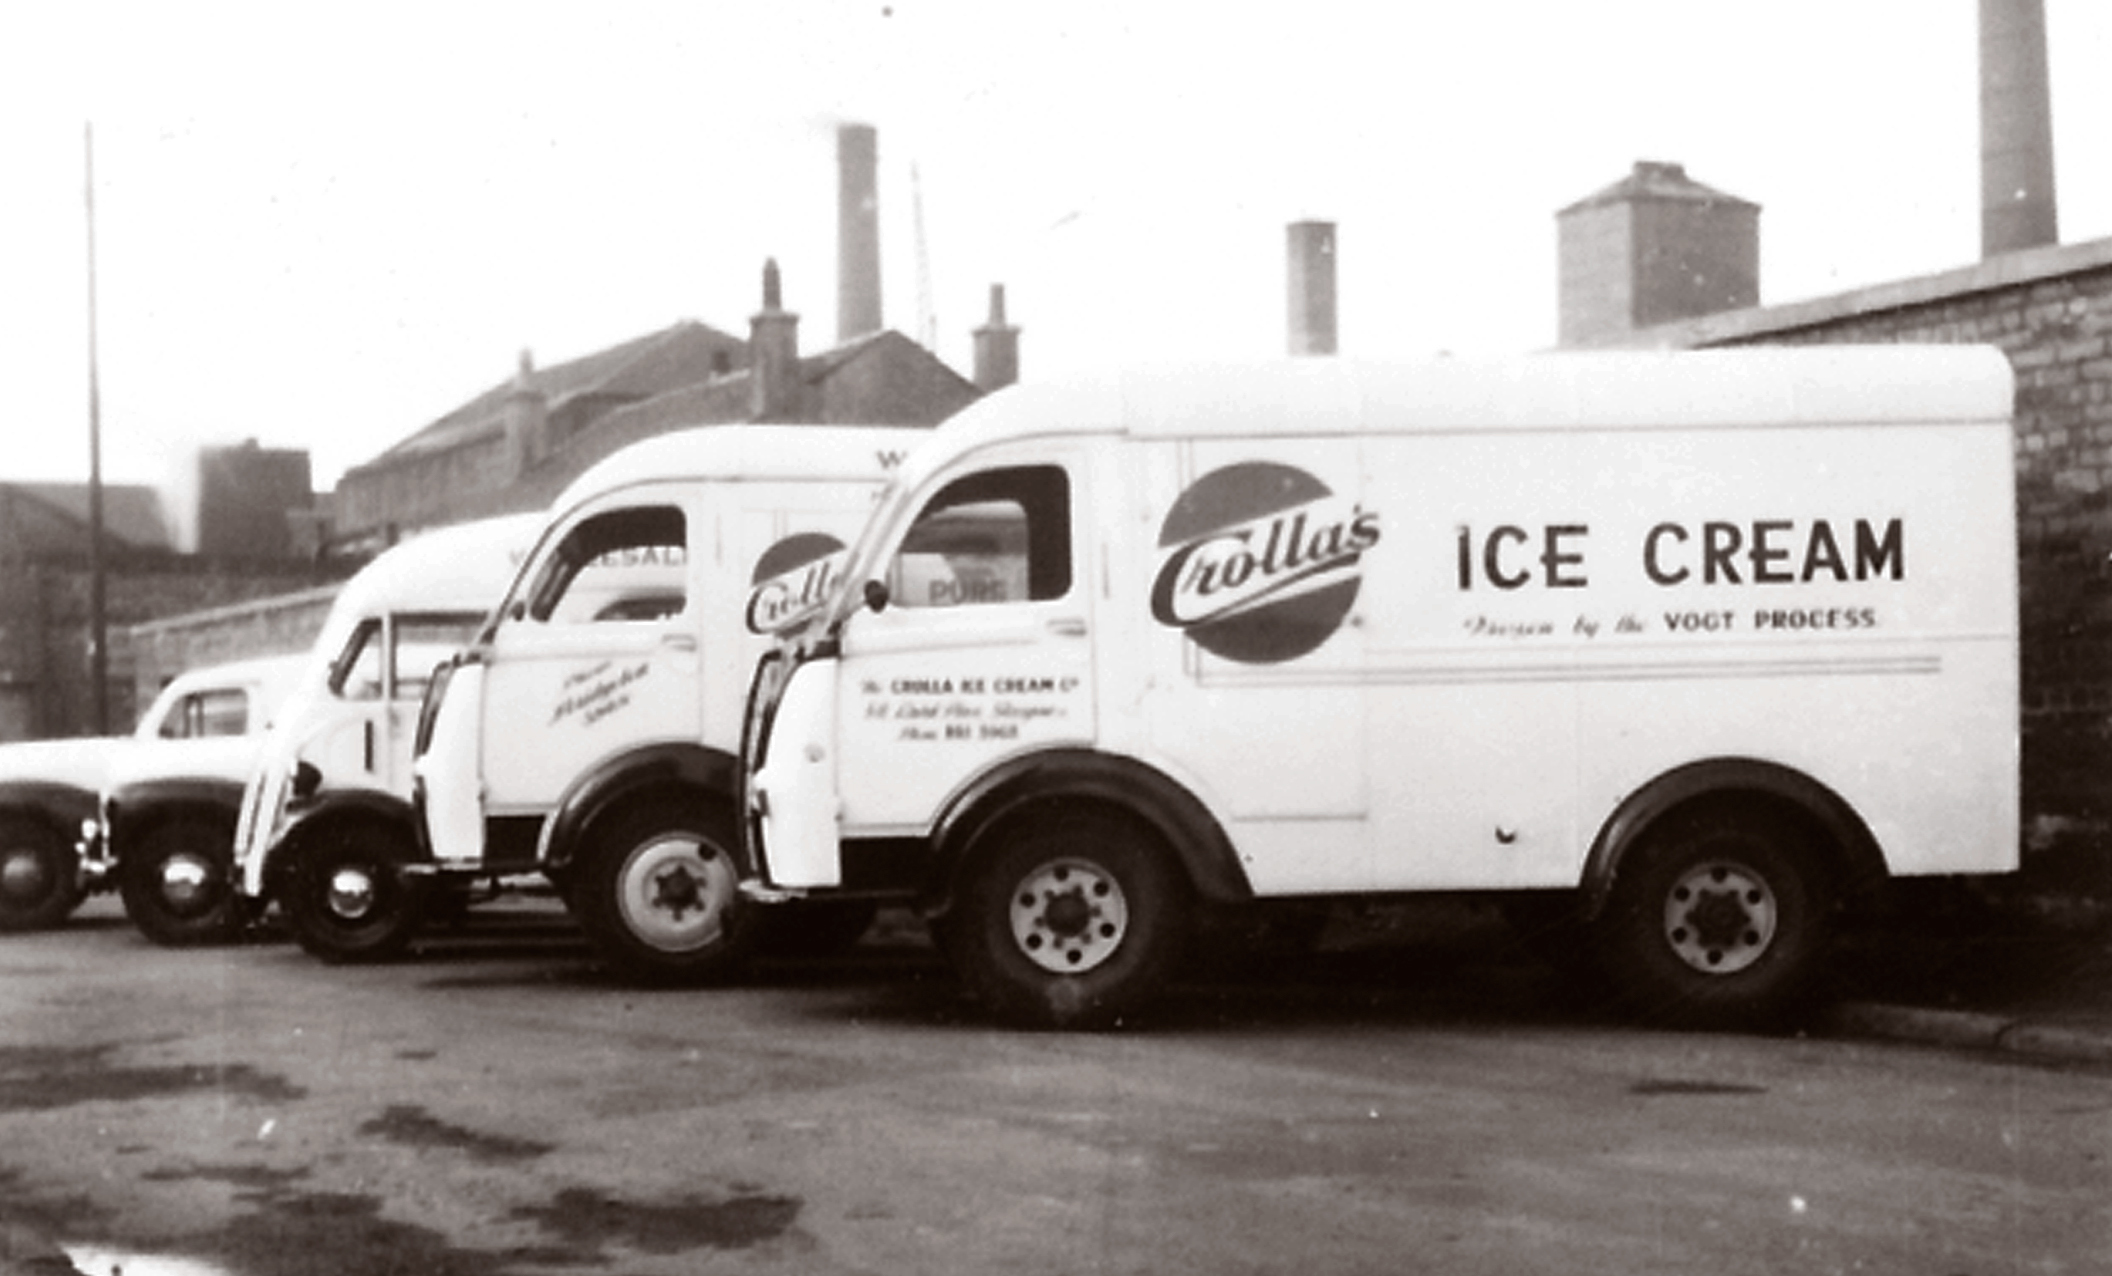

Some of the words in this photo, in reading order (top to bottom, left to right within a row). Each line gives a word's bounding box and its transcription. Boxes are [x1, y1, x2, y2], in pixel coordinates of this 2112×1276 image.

[1151, 504, 1380, 627] Crolla's
[1457, 524, 1589, 590] ICE
[1643, 518, 1904, 585] CREAM
[1664, 611, 1733, 632] VOGT
[1754, 608, 1876, 630] PROCESS
[890, 678, 954, 694] CROLLA
[960, 678, 985, 694] ICE
[993, 677, 1054, 694] CREAM
